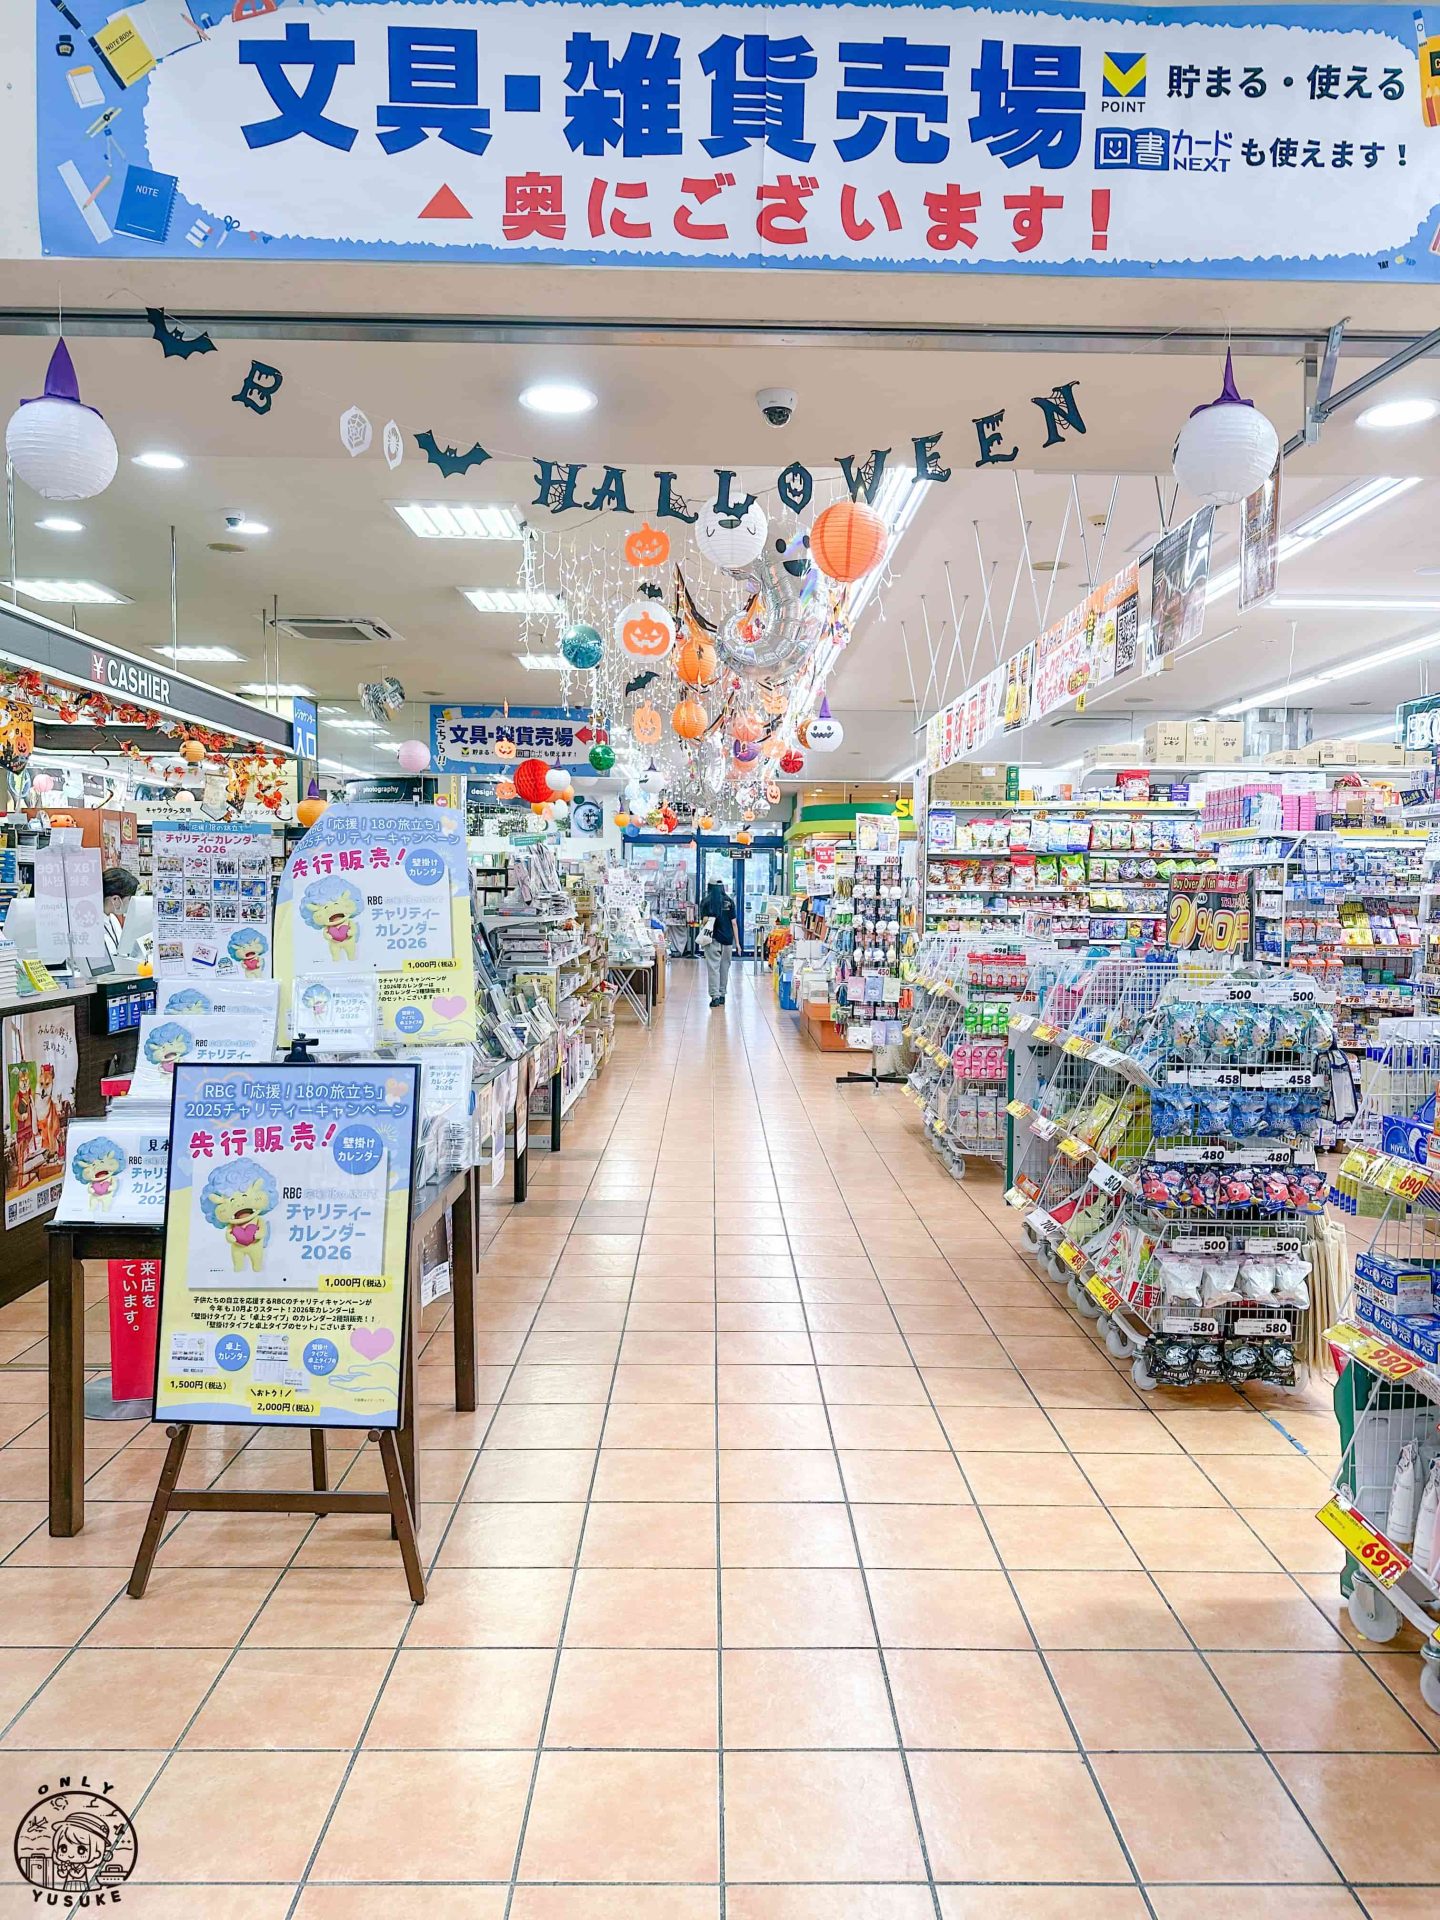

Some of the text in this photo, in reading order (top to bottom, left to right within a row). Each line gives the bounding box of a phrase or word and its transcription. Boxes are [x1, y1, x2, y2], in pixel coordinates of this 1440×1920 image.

[1168, 63, 1407, 102] 貯まる・使える
[238, 23, 1086, 170] 文具・雑貨売場
[1101, 101, 1146, 113] POINT
[1172, 129, 1233, 156] カード
[1241, 137, 1407, 169] も使えます！
[1174, 157, 1231, 173] NEXT
[135, 185, 159, 199] NOTE
[501, 171, 1110, 254] 奥にございます！
[532, 380, 1087, 525] HALLOWEEN
[107, 659, 171, 704] CASHIER
[295, 726, 317, 760] 入口
[363, 785, 399, 795] photography
[471, 788, 494, 797] design
[165, 834, 258, 845] チャリティーカレンダー
[197, 845, 227, 854] 2026
[291, 847, 407, 879] 先行販売！
[412, 858, 438, 869] 壁掛け
[408, 868, 442, 877] カレンダー
[1173, 877, 1184, 889] Buy
[1184, 878, 1198, 889] Over
[1207, 877, 1216, 889] Yen
[366, 895, 383, 905] RBC
[371, 908, 441, 921] チャリティー
[375, 923, 438, 938] カレンダー
[386, 938, 428, 950] 2026
[1228, 989, 1252, 1001] 500
[1292, 991, 1314, 1002] 500
[195, 1039, 208, 1047] RBC
[197, 1049, 252, 1060] チャリティー
[430, 1070, 460, 1079] チャリティー
[1217, 1074, 1240, 1085] 458
[1288, 1074, 1312, 1085] 458
[431, 1077, 459, 1085] カレンダー
[186, 1102, 408, 1119] 2025チャリティーキャンペーン
[189, 1121, 338, 1158] 先行販売！
[342, 1137, 376, 1149] 壁掛け
[1201, 1149, 1225, 1161] 480
[1389, 1143, 1408, 1155] NIVEA
[128, 1156, 143, 1165] RBC
[337, 1149, 379, 1162] カレンダー
[1267, 1152, 1290, 1163] 480
[1398, 1174, 1423, 1195] 890
[283, 1187, 302, 1200] RBC
[286, 1203, 372, 1221] チャリティー
[289, 1223, 367, 1243] カレンダー
[1204, 1240, 1226, 1250] 500
[1275, 1242, 1299, 1252] 500
[301, 1244, 352, 1260] 2026
[1070, 1253, 1086, 1270] 498
[1379, 1277, 1394, 1289] AD
[1101, 1291, 1120, 1311] 498
[1360, 1305, 1373, 1317] AD
[1192, 1321, 1215, 1332] 580
[1265, 1323, 1288, 1333] 580
[1379, 1318, 1393, 1330] AD
[1398, 1332, 1412, 1344] AD
[225, 1342, 242, 1351] 卓上
[1421, 1345, 1435, 1357] AD
[218, 1352, 248, 1361] カレンダー
[1367, 1347, 1413, 1374] 980
[1196, 1367, 1210, 1375] BATH
[1361, 1541, 1402, 1580] 698
